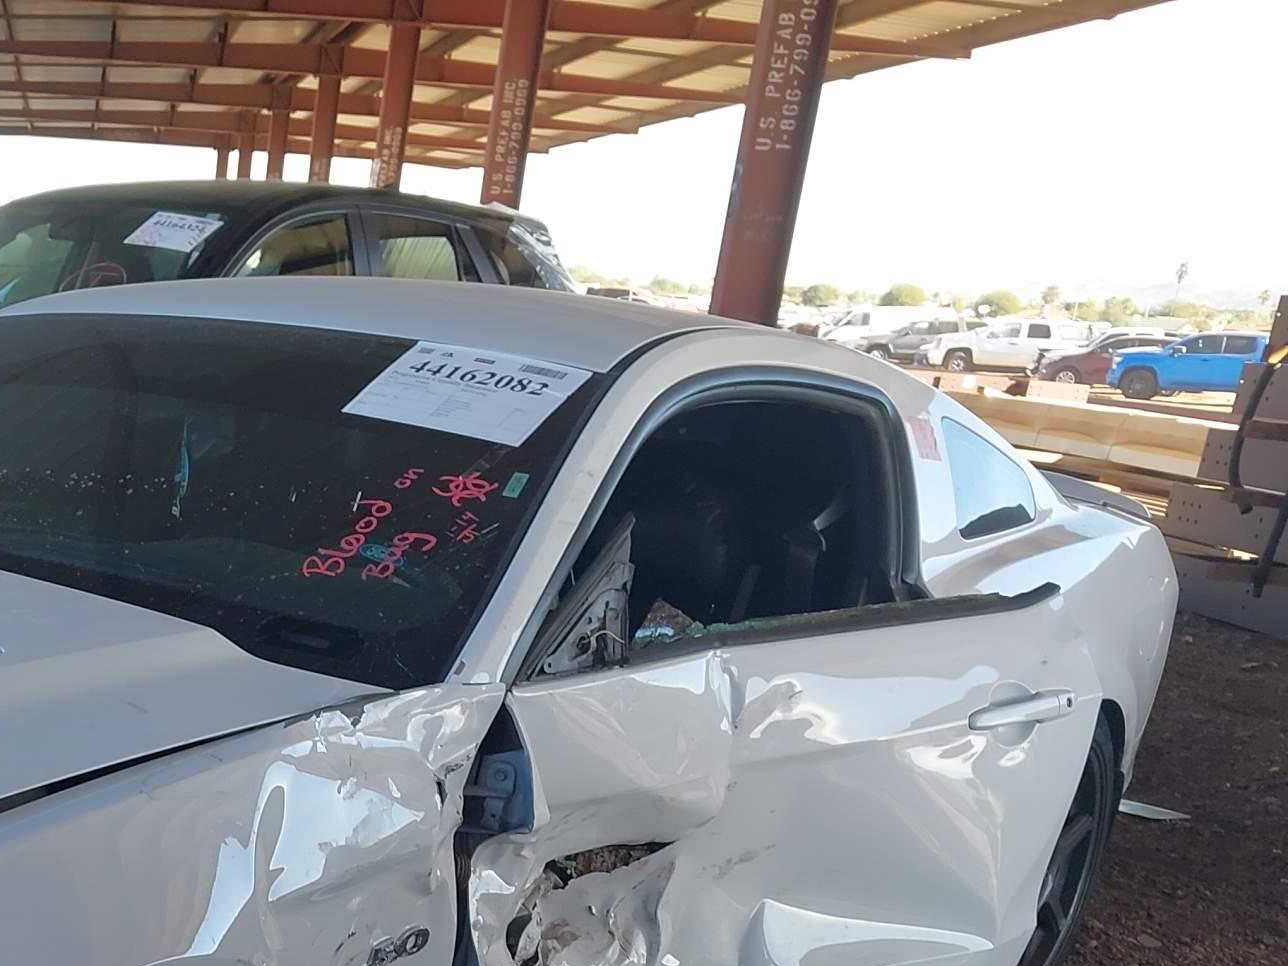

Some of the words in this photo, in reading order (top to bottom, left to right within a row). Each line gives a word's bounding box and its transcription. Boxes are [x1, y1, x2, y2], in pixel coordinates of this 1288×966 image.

[765, 13, 796, 98] PREFAB
[495, 109, 512, 162] PREFAB
[409, 360, 550, 396] 44162082
[302, 498, 393, 577] Blood
[362, 531, 437, 580] Bag
